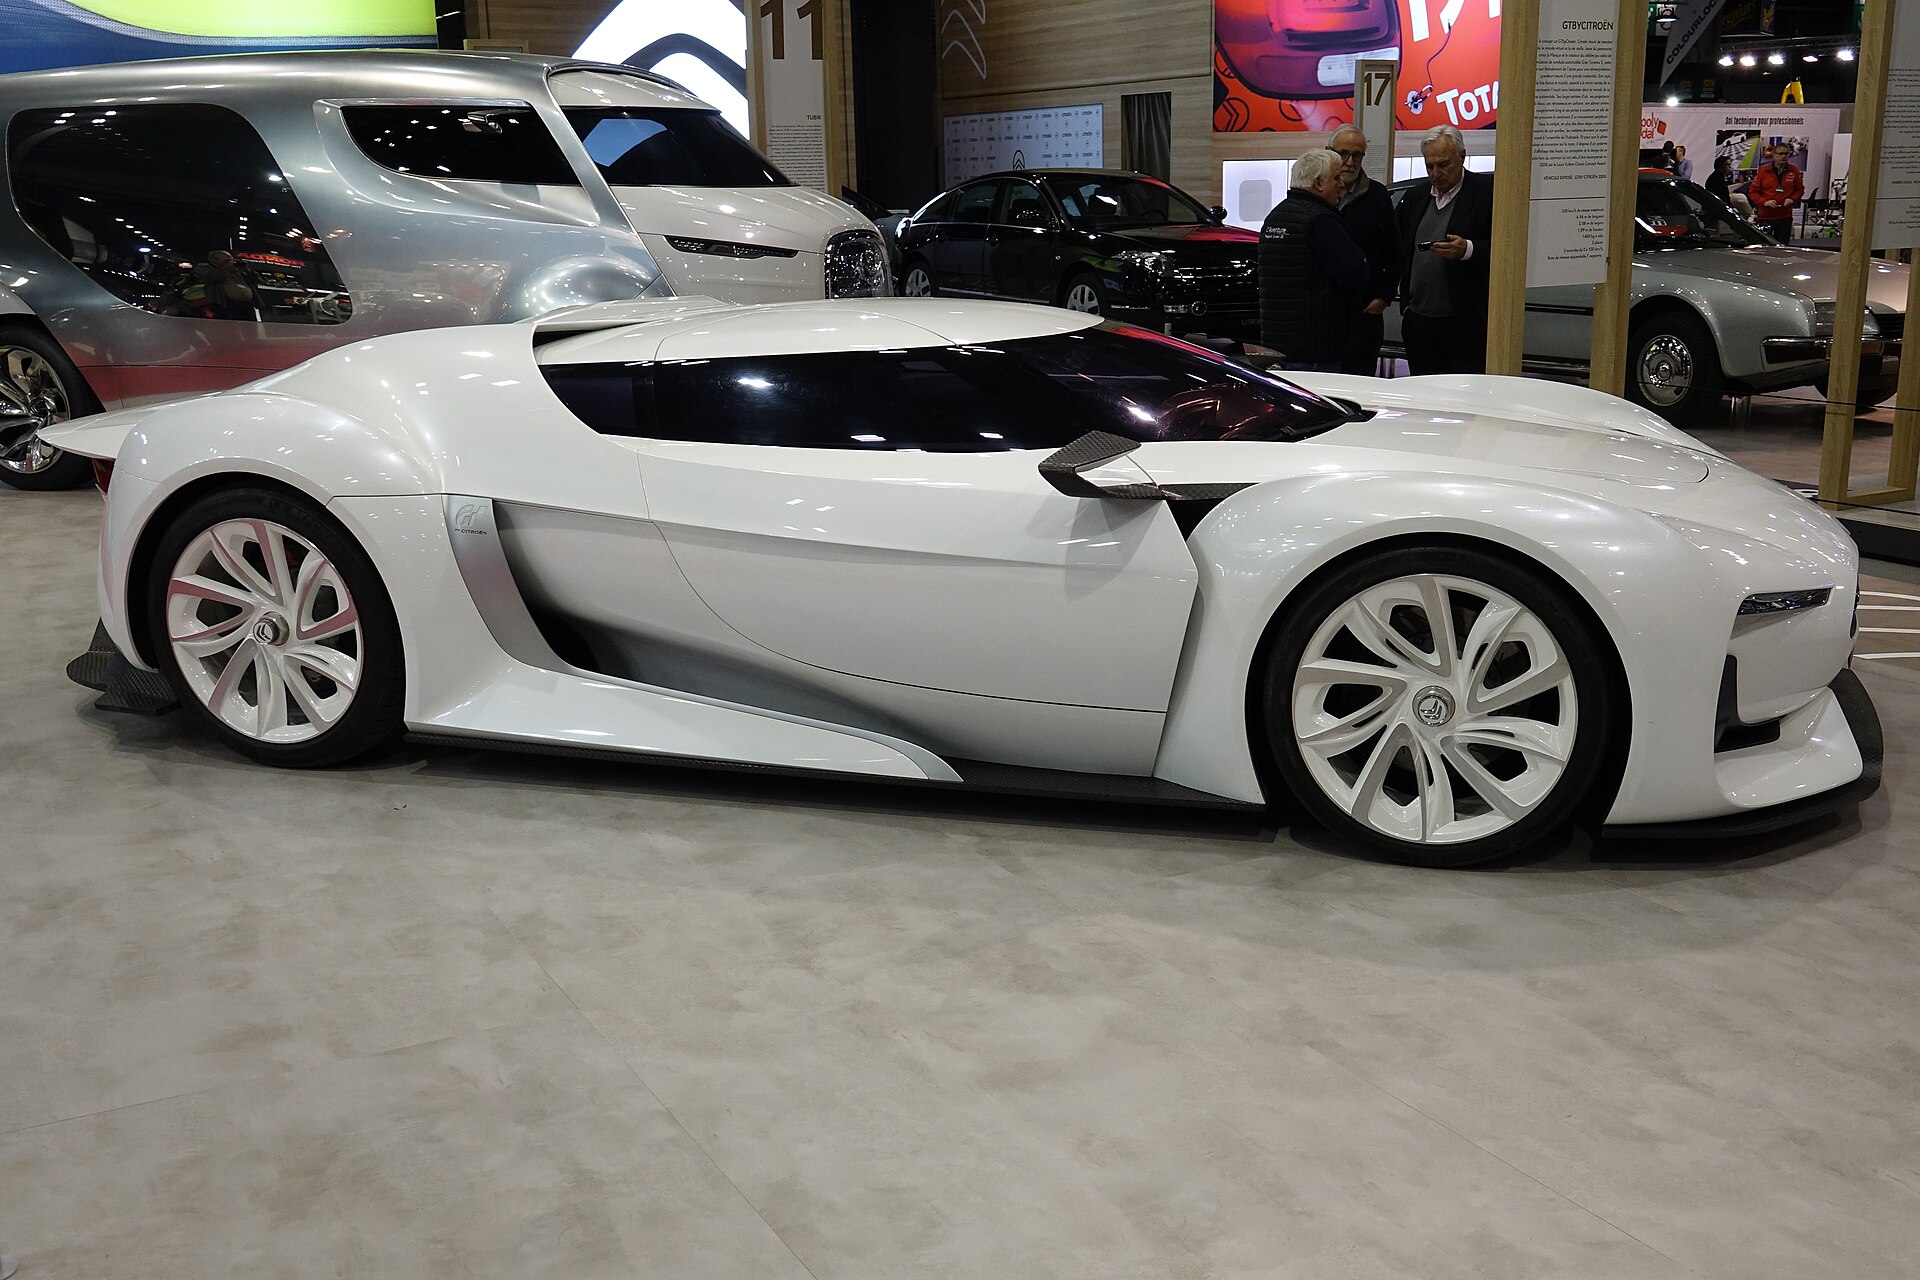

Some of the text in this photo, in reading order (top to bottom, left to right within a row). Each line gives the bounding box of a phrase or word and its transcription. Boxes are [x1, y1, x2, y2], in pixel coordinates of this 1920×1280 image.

[761, 0, 823, 60] 11
[1562, 20, 1614, 30] GTBYCITROËN
[1364, 72, 1391, 106] 17
